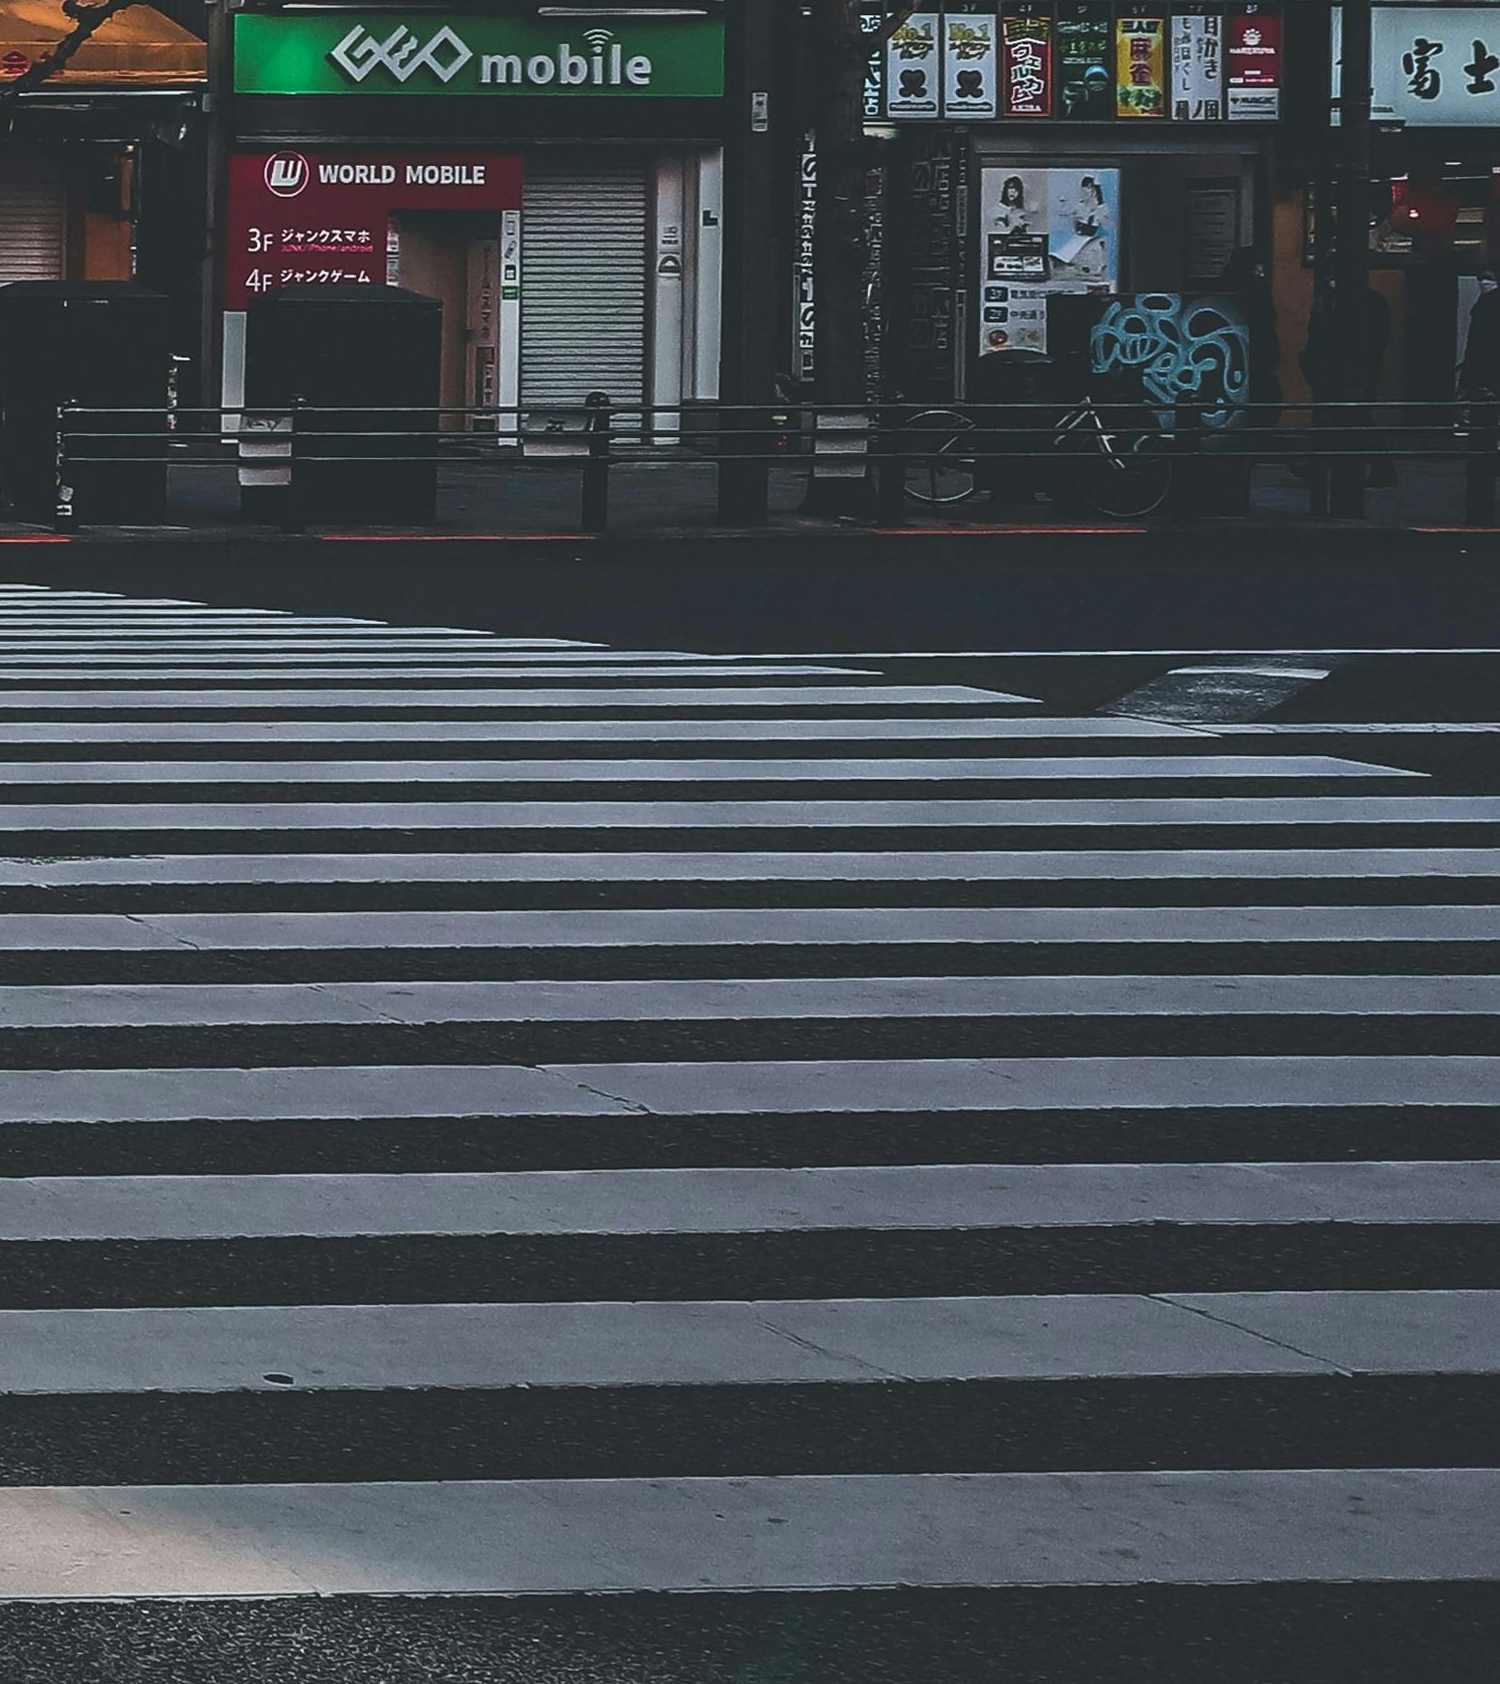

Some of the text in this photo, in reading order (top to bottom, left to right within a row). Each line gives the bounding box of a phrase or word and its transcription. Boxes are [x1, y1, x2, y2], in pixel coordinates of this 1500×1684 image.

[330, 24, 652, 86] GEO mobile
[1402, 37, 1500, 101] 富士
[318, 164, 486, 185] WORLD MOBILE
[247, 227, 371, 253] 3F ジャンクスマホ
[244, 268, 371, 293] 4F ジャンクゲーム
